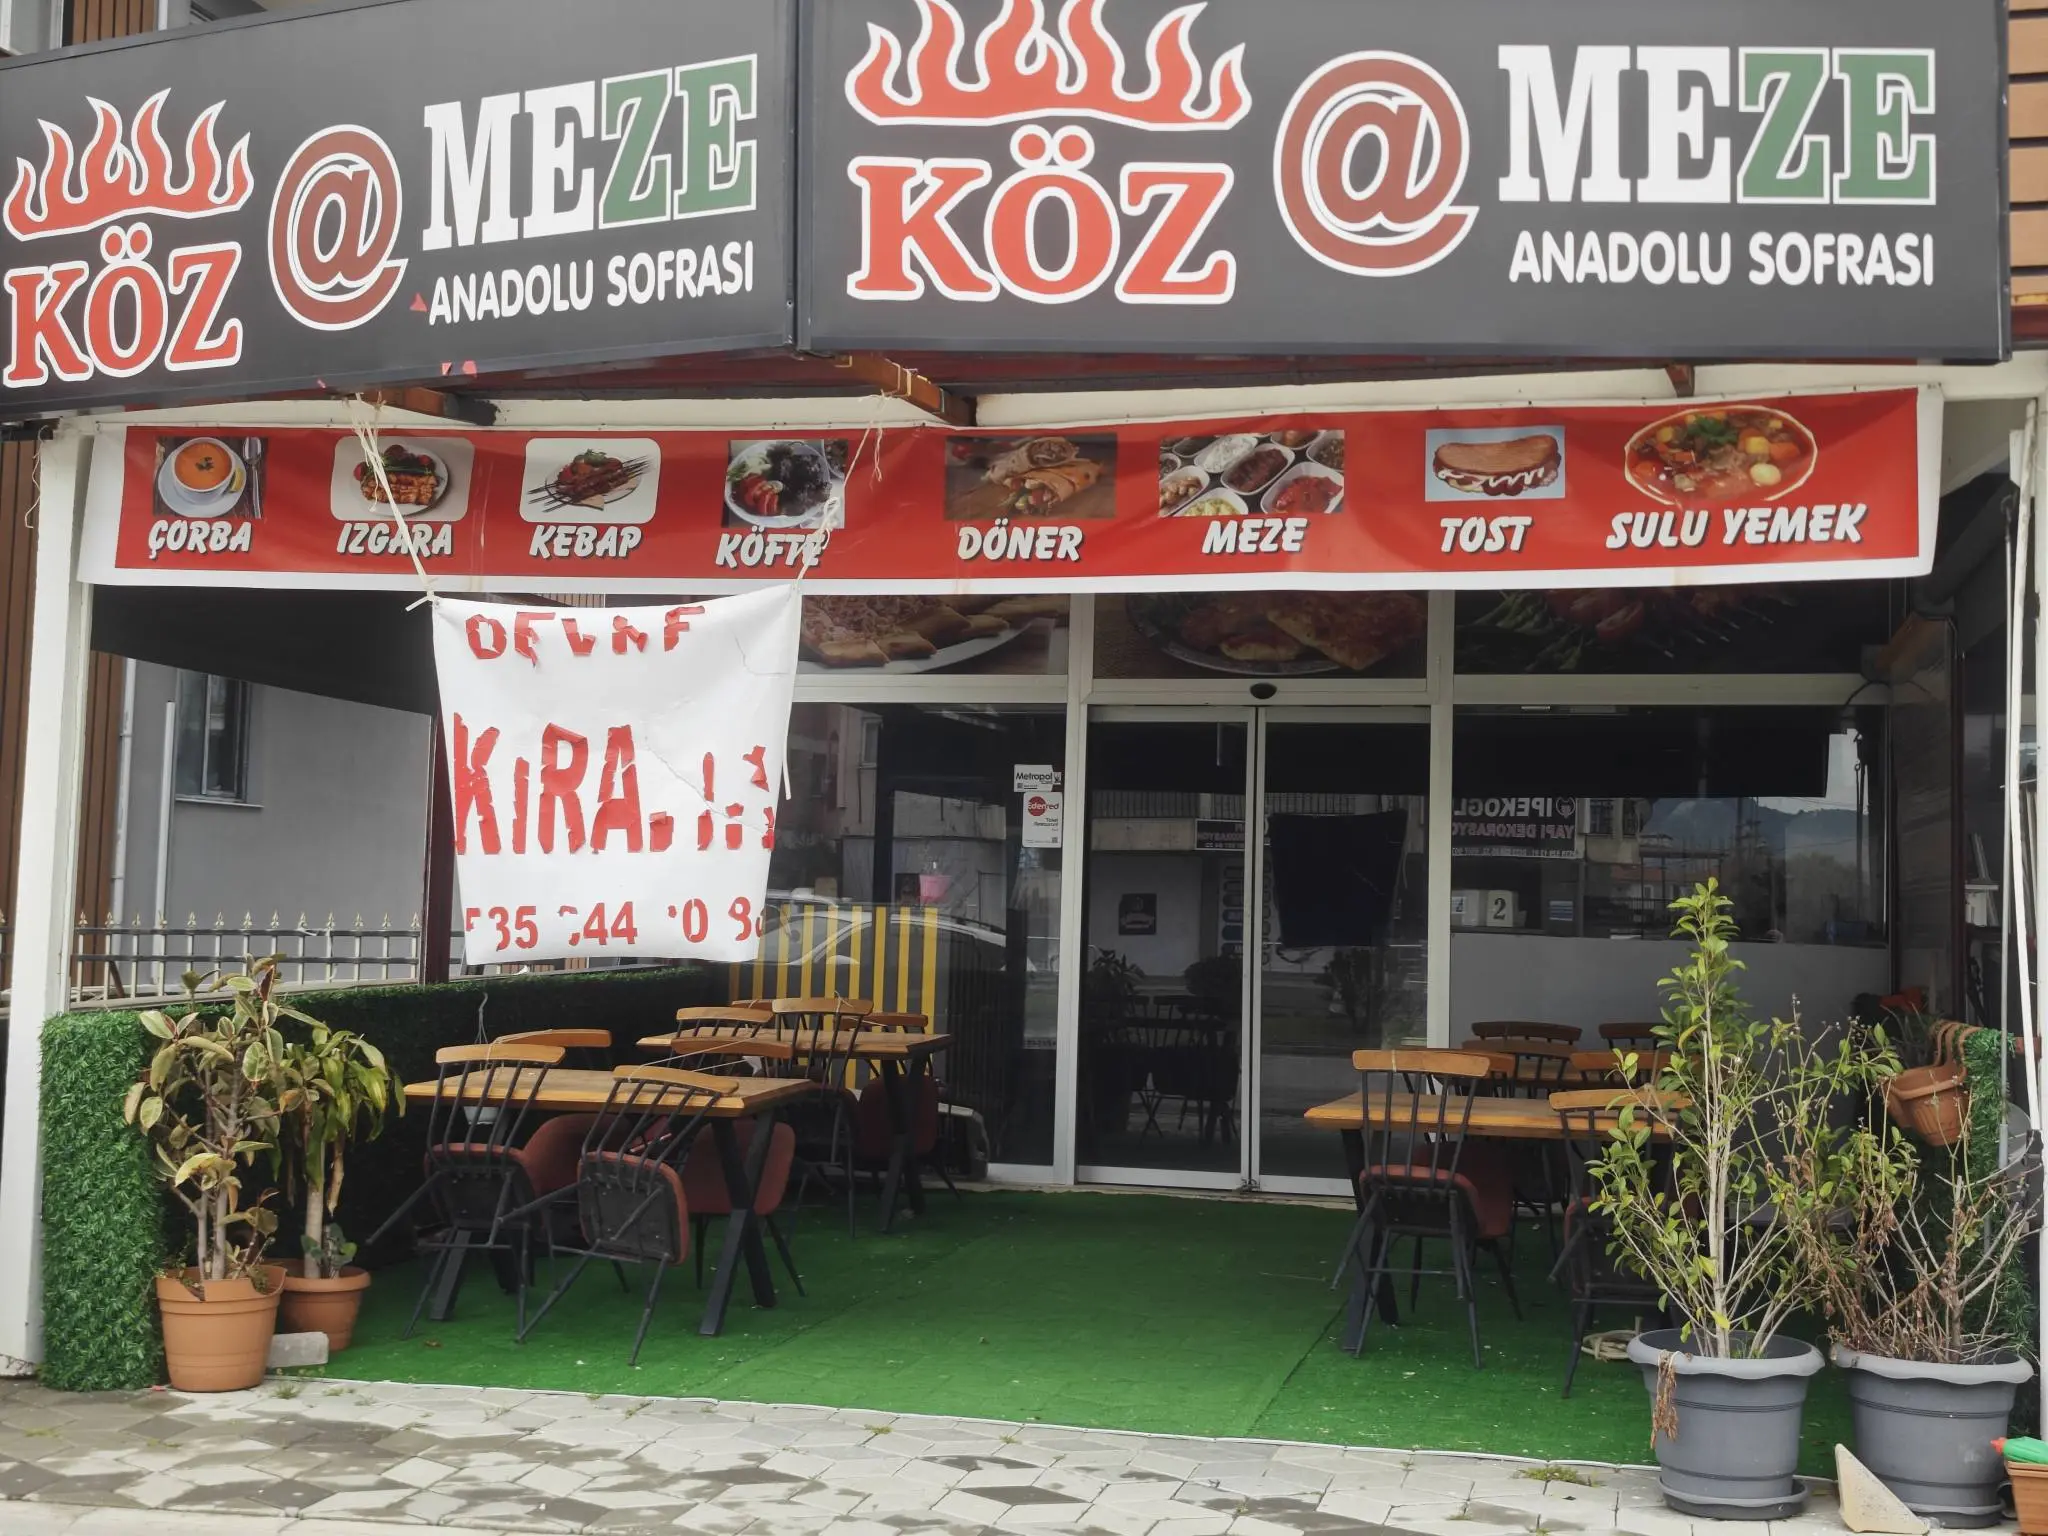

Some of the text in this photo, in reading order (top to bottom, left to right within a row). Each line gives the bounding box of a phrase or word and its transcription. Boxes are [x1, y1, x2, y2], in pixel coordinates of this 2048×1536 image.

[847, 122, 1238, 304] KÖZ
[1498, 45, 1937, 206] MEZE
[3, 222, 243, 389] KÖZ
[423, 53, 758, 250] MEZE
[1509, 231, 1934, 287] ANADOLU SOFRASI
[428, 240, 754, 325] ANADOLU SOFRASI
[148, 520, 253, 560] ÇORBA
[336, 522, 453, 557] IZGARA
[529, 525, 643, 559] KEBAP
[716, 526, 823, 568] KÖFTE
[957, 518, 1084, 562] DÖNER
[1202, 518, 1308, 555] MEZE
[1440, 516, 1534, 553] TOST
[1605, 503, 1868, 550] SULU YEMEK
[1016, 772, 1052, 782] Metropol
[1028, 802, 1059, 810] Edenred
[559, 901, 638, 946] 44
[668, 898, 709, 943] 0
